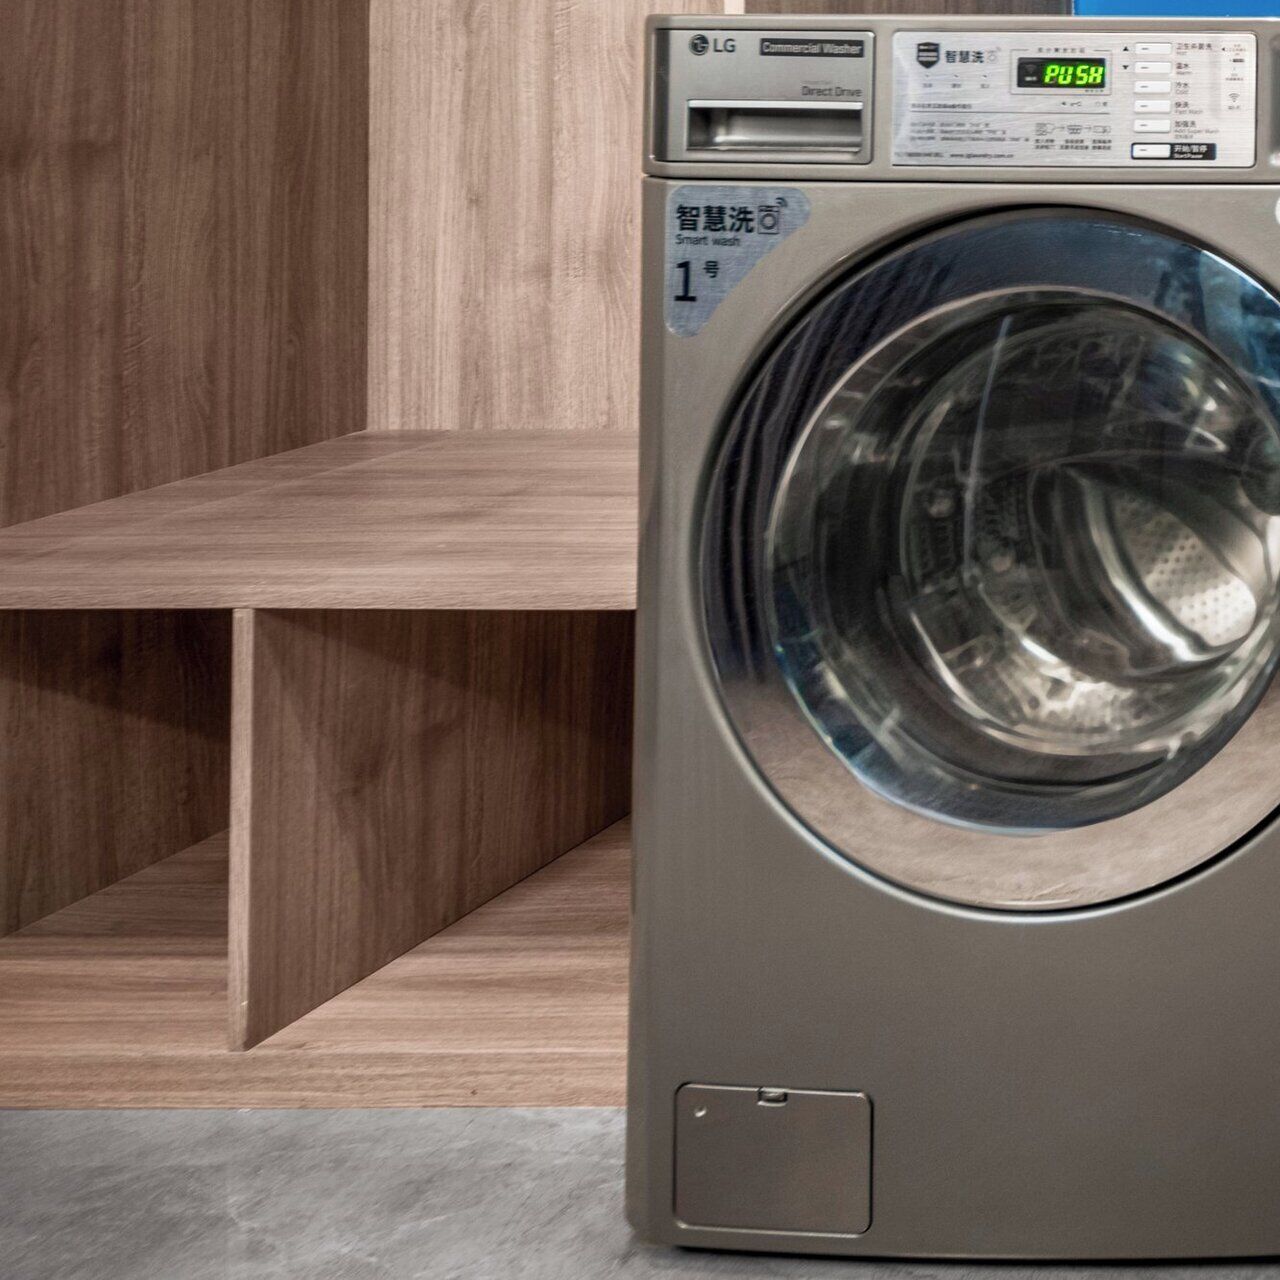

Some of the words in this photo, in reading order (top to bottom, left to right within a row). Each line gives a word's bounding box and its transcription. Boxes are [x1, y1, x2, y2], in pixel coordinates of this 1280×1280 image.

[713, 38, 736, 53] LG
[762, 42, 821, 54] Commercial
[823, 43, 862, 54] Washer
[945, 50, 984, 64] 智慧洗
[1044, 64, 1104, 84] PUSH
[802, 86, 832, 96] Direct
[835, 87, 862, 97] Drive
[676, 205, 754, 234] 智慧洗
[676, 234, 708, 245] Smart
[713, 236, 741, 246] wash
